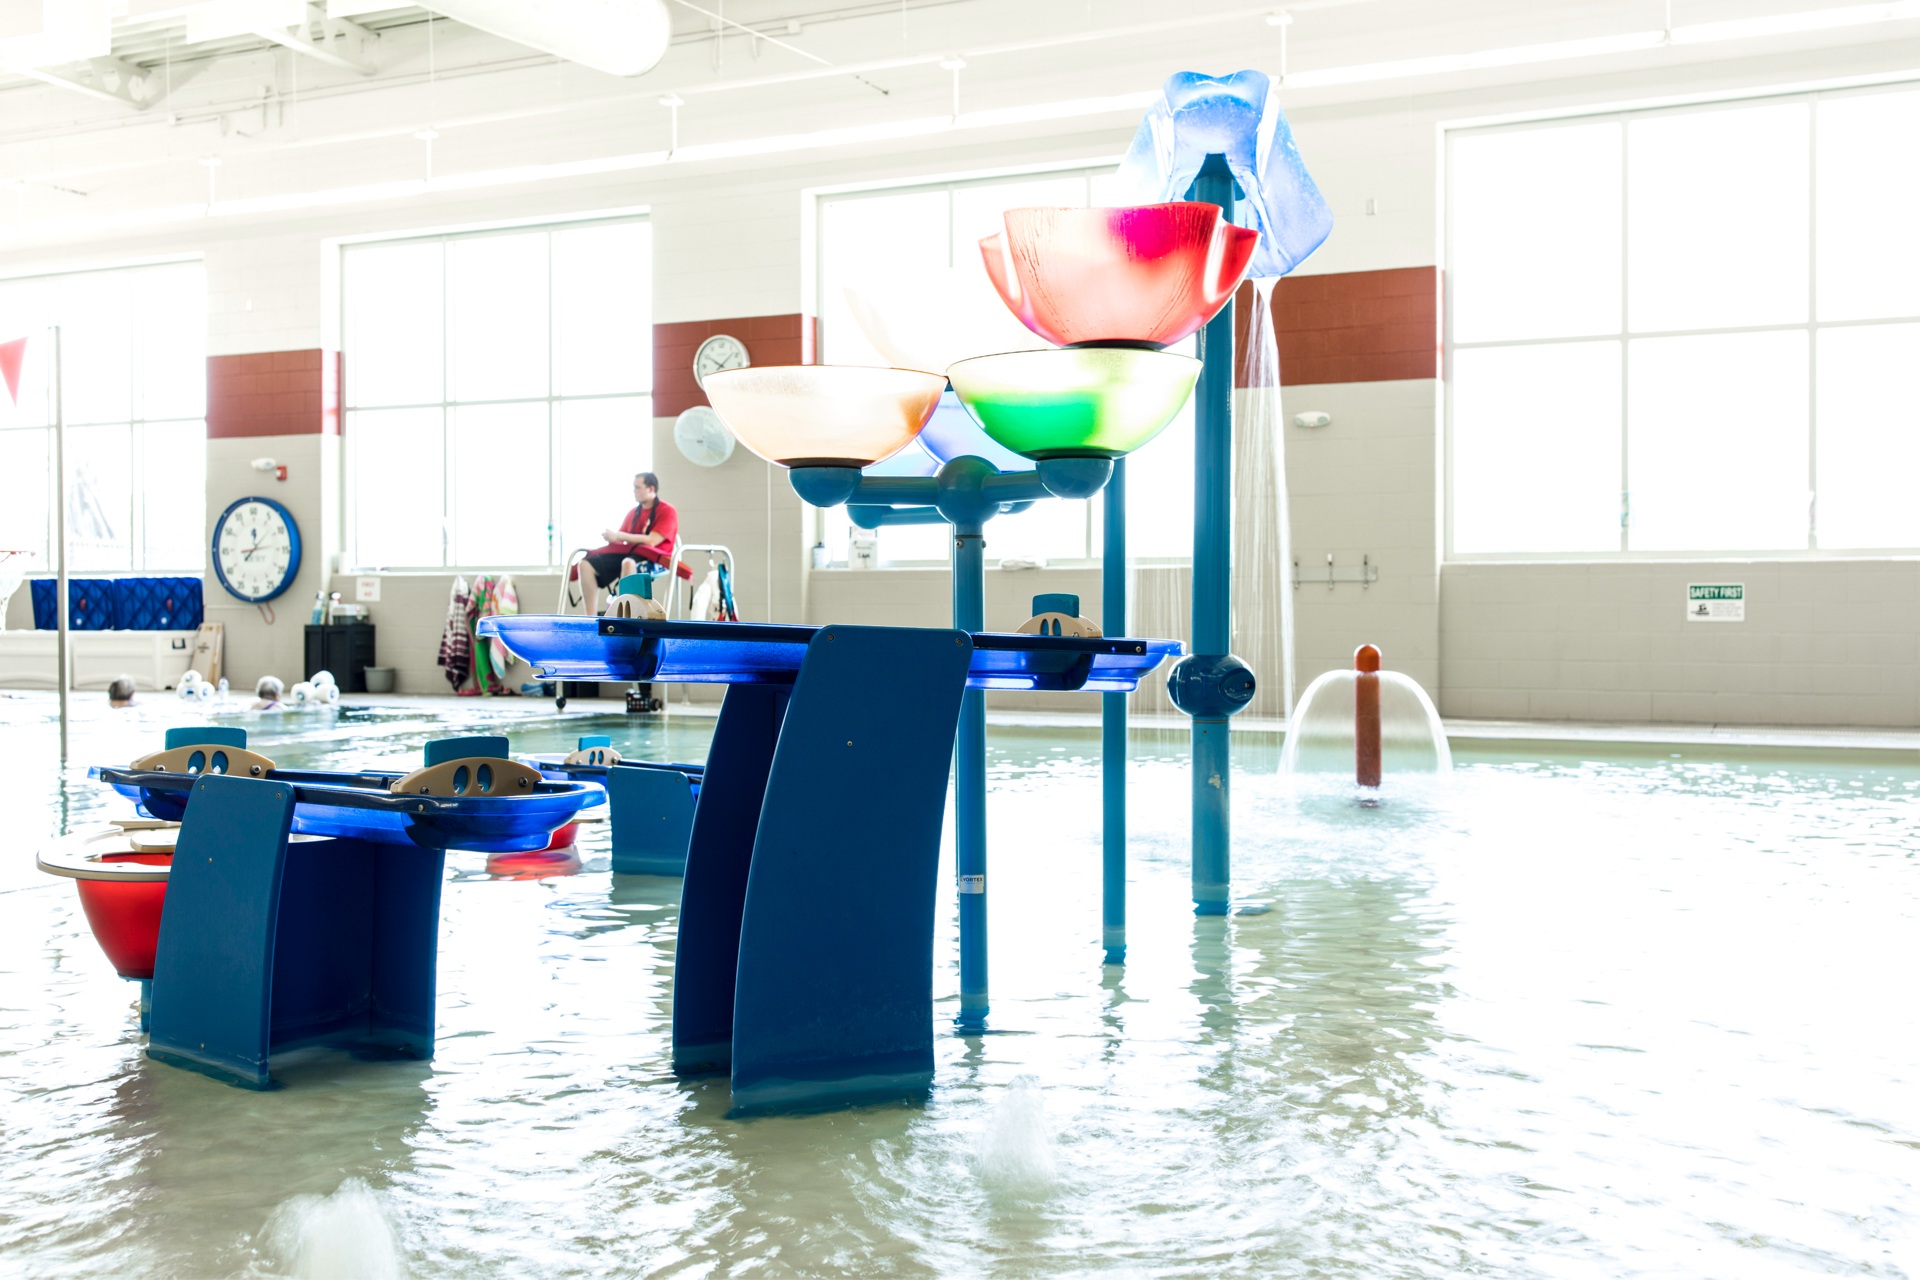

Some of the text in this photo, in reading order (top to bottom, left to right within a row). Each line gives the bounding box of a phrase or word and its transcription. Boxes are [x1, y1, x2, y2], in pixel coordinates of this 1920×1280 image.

[250, 507, 258, 516] 60
[225, 527, 233, 536] 50
[278, 526, 284, 534] 10
[222, 548, 230, 556] 45
[282, 546, 290, 554] 15
[226, 567, 234, 575] 40
[278, 566, 286, 574] 20
[237, 580, 245, 589] 35
[266, 580, 275, 588] 25
[252, 586, 260, 594] 30
[1690, 587, 1742, 598] SAFETY FIRST
